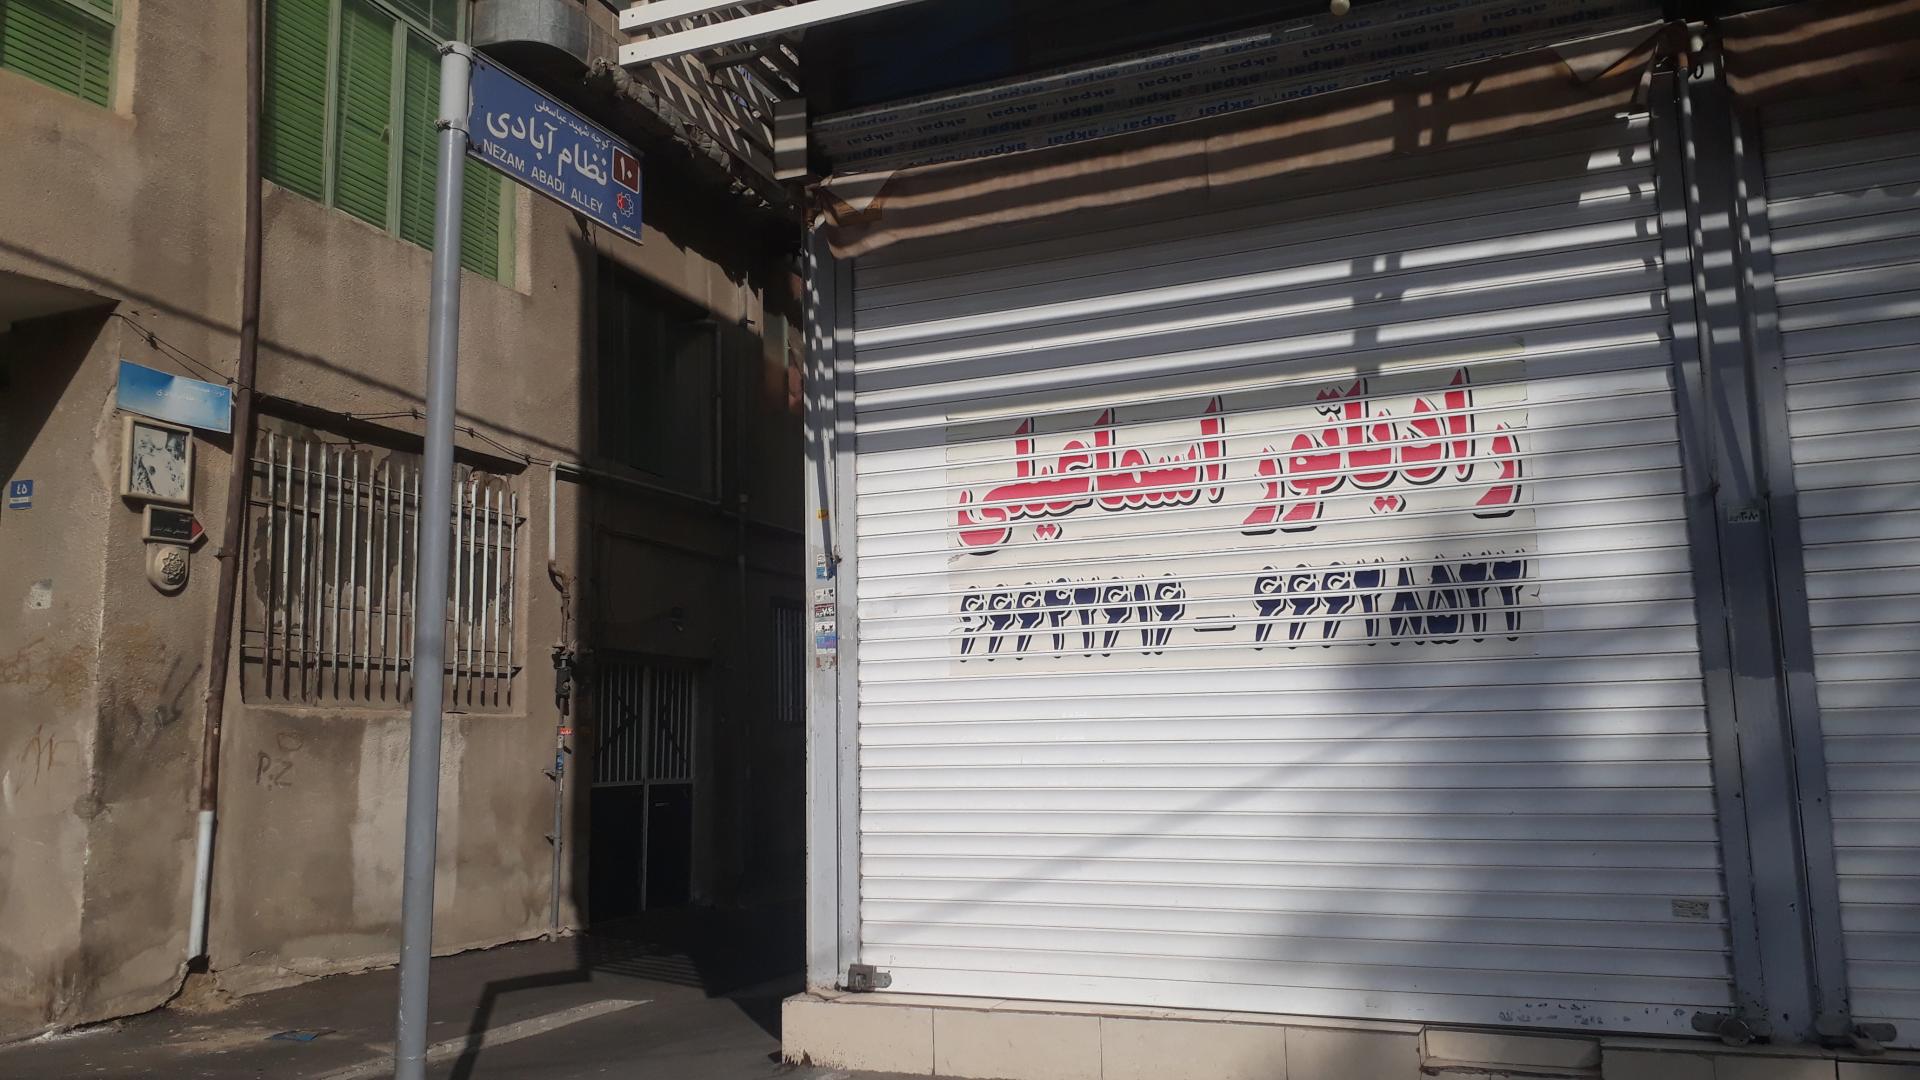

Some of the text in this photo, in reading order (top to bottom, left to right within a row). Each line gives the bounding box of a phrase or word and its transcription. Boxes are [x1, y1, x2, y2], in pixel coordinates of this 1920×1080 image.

[486, 111, 608, 187] نظام آبادی
[568, 121, 590, 138] شهید
[591, 132, 611, 151] کوچه
[483, 138, 604, 214] NEZAM ABADI ALLEY
[620, 155, 633, 182] ۱۰
[957, 366, 1523, 555] رادیاتور اسماعیلی
